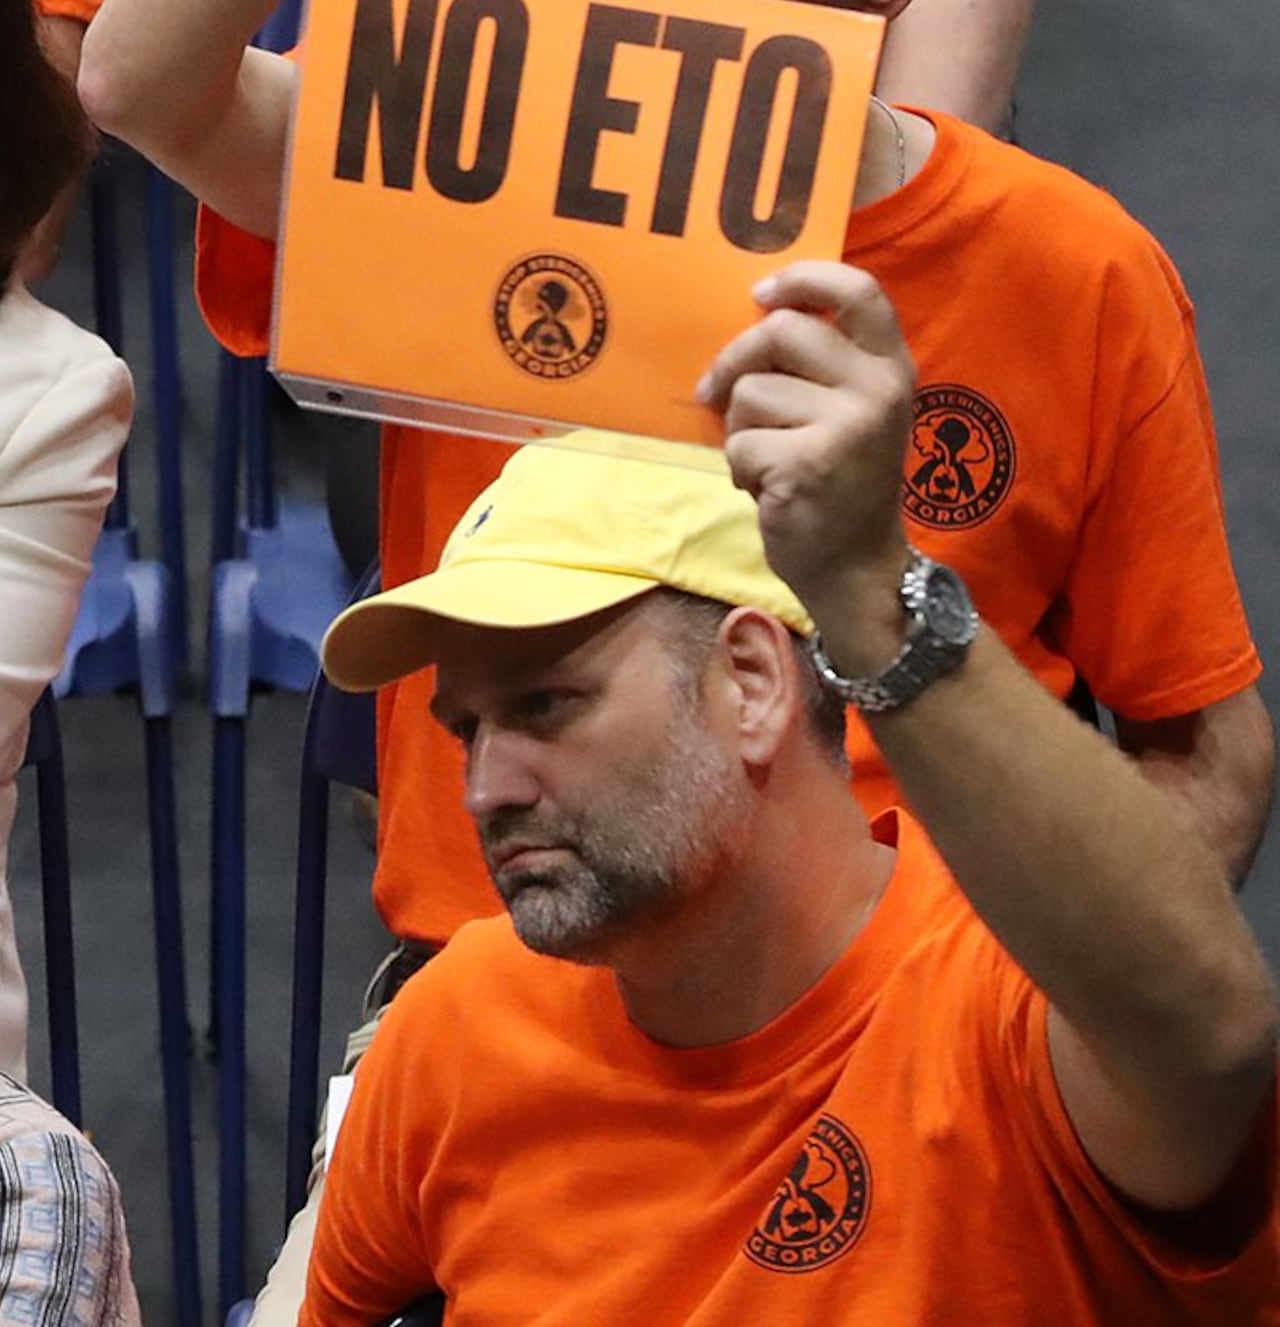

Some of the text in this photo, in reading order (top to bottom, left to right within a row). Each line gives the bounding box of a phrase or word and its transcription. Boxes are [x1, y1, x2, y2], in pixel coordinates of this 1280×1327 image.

[556, 7, 827, 249] ETO
[504, 339, 592, 377] GEORGIA
[906, 494, 990, 522] EORGIA
[750, 1219, 858, 1263] GEORGIA
